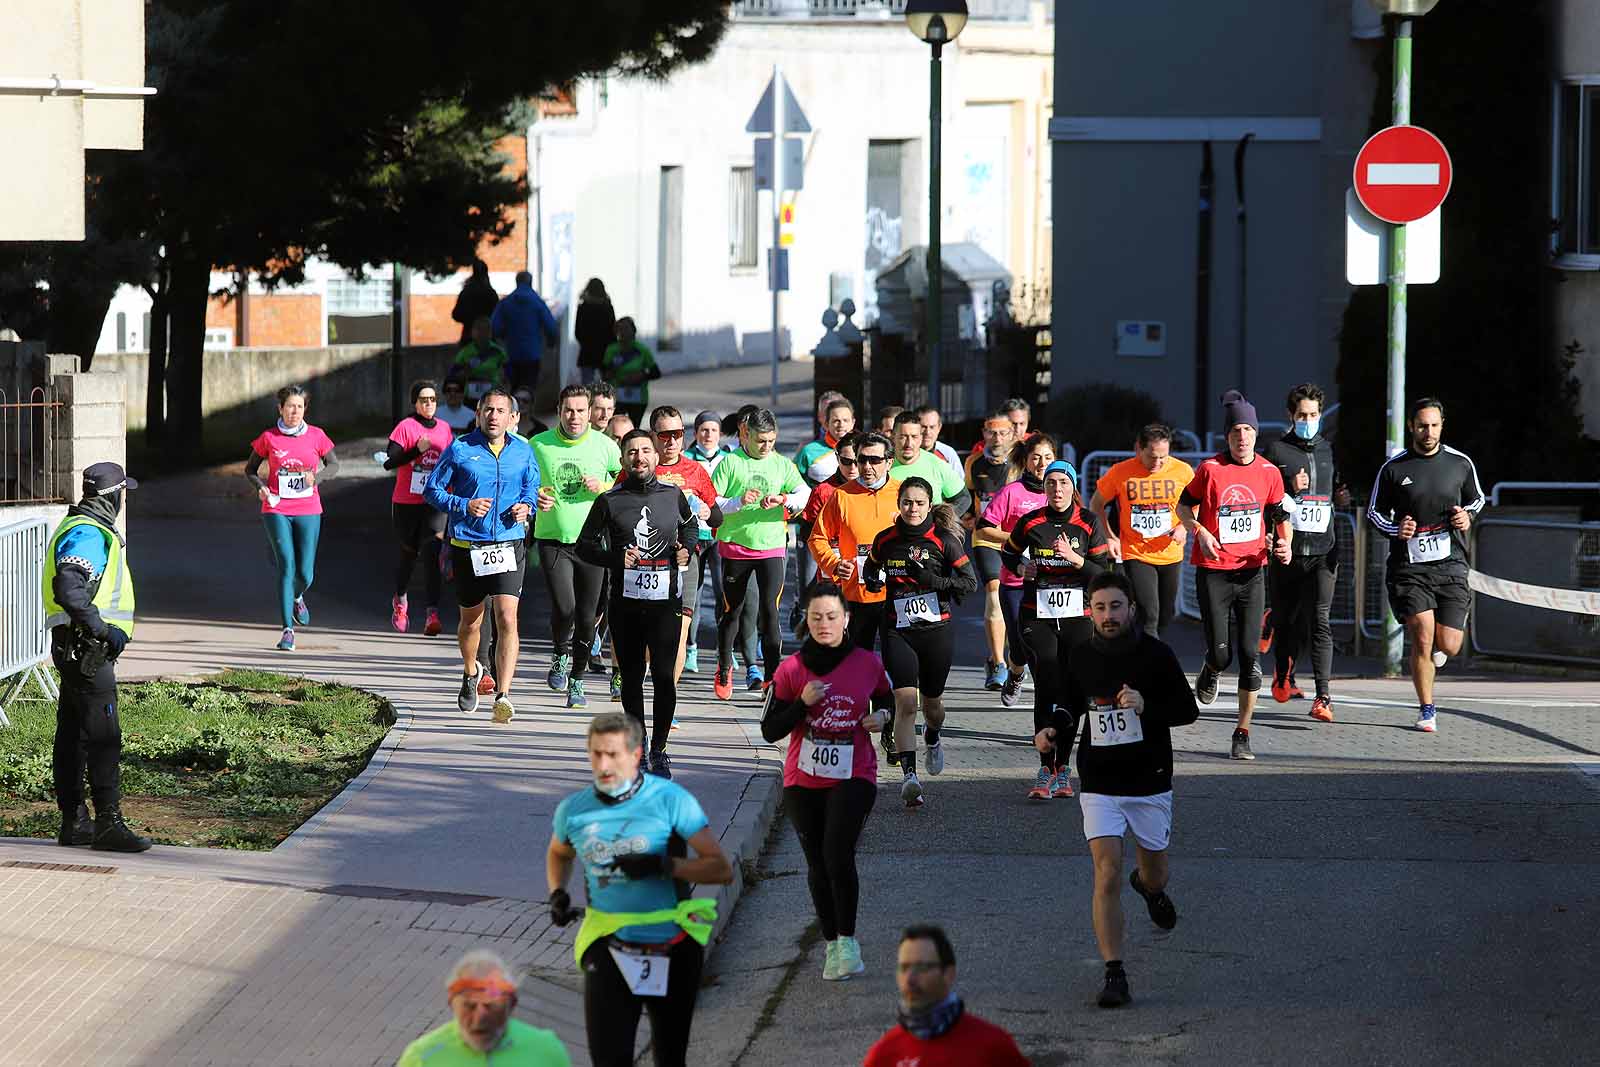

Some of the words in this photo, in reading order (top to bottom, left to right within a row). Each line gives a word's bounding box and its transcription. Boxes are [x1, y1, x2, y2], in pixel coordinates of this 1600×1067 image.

[288, 477, 304, 490] 421
[1127, 479, 1176, 501] BEER
[1141, 515, 1161, 529] 306
[1300, 507, 1321, 522] 510
[1230, 517, 1252, 533] 499
[1418, 536, 1439, 553] 511
[481, 549, 504, 566] 263
[635, 572, 659, 590] 433
[904, 597, 928, 616] 408
[1048, 590, 1072, 608] 407
[1098, 711, 1126, 734] 515
[811, 747, 839, 767] 406
[640, 959, 651, 980] 3
